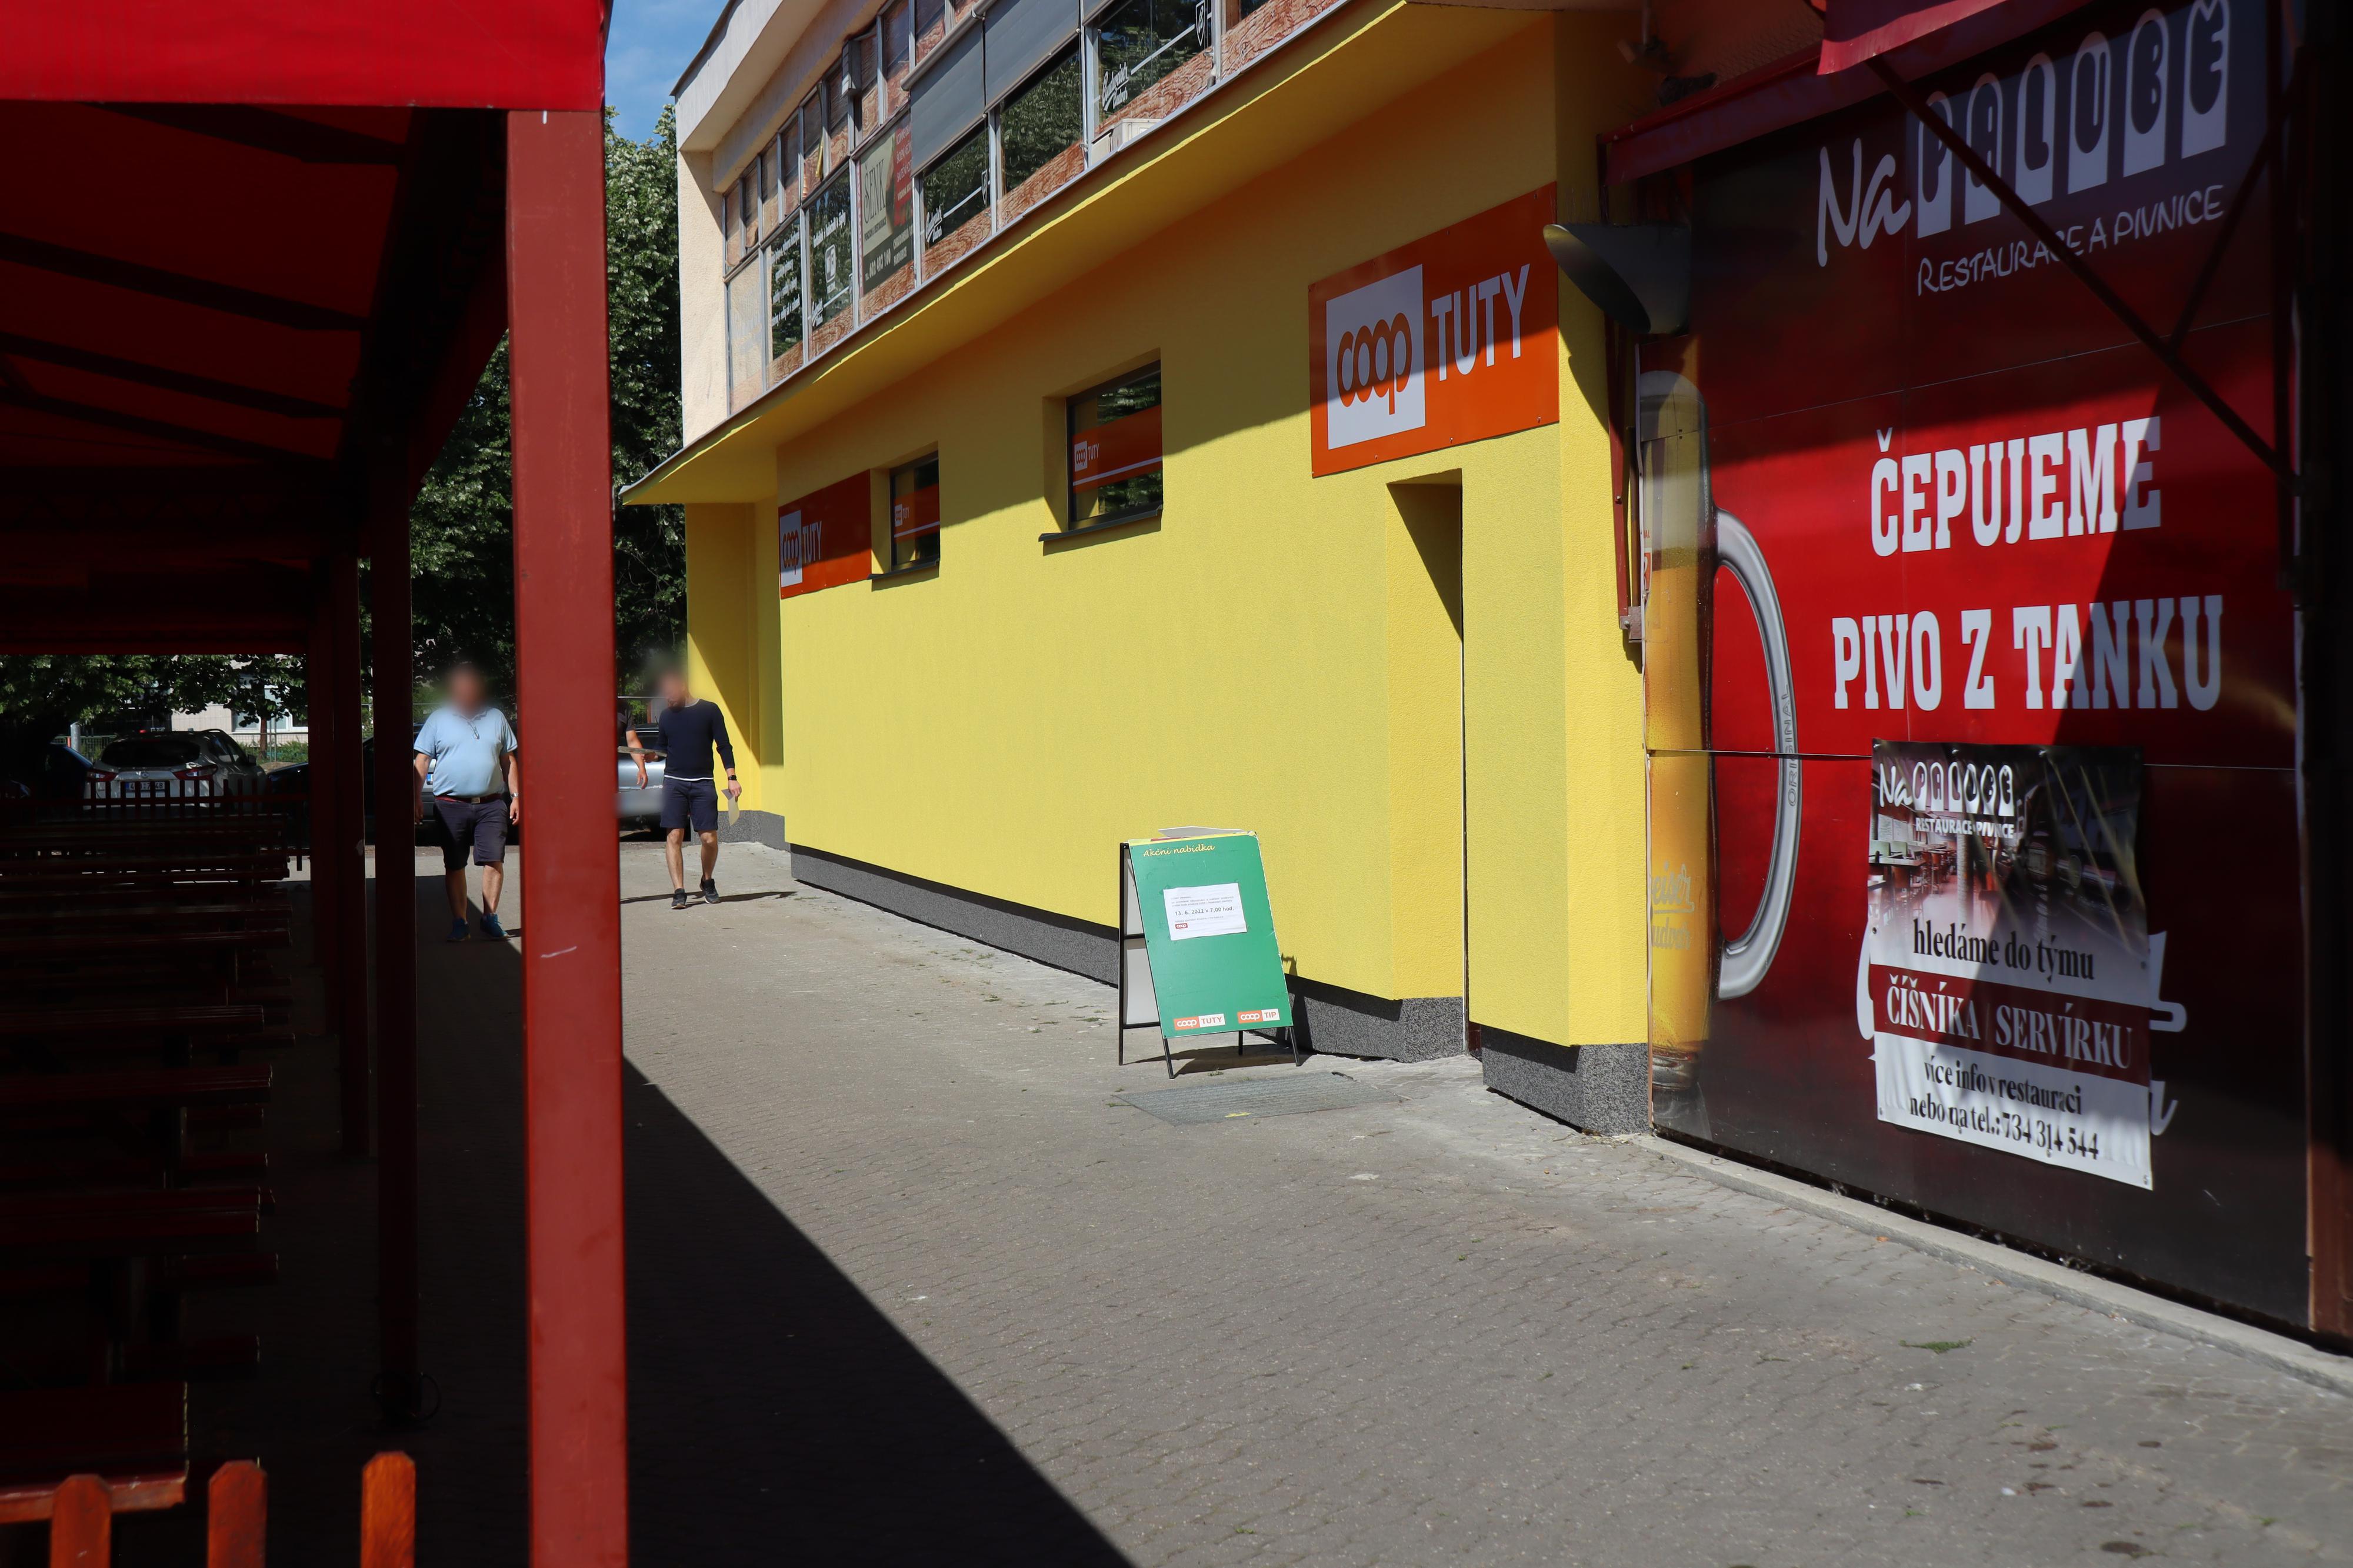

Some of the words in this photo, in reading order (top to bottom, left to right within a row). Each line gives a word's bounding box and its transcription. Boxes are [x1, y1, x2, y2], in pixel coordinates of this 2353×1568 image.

[864, 158, 886, 223] ŠENK
[1818, 138, 1911, 268] Na
[2089, 218, 2107, 253] A
[2114, 185, 2224, 245] PIVNICE
[1337, 312, 1412, 415] coop
[1431, 263, 1531, 382] TUTY
[1088, 443, 1099, 461] TUTY
[1871, 415, 2162, 557] ČEPUJEME
[783, 529, 799, 576] coop
[802, 521, 822, 563] TUTY
[1831, 610, 1942, 711] PIVO
[1961, 609, 1996, 709] Z
[2012, 595, 2224, 711] TANKU
[1879, 763, 1914, 808] Na
[1173, 843, 1215, 854] nabídka
[1915, 817, 1973, 835] RESTAURACE
[1913, 918, 1999, 966] hledáme
[2004, 930, 2031, 970] do
[2037, 935, 2095, 983] týmu
[1177, 1019, 1197, 1027] coop
[1201, 1016, 1222, 1025] TUTY
[1240, 1013, 1260, 1021] coop
[1887, 973, 1981, 1040] ČÍŠNÍKA
[1995, 1002, 2133, 1069] SERVÍRKU
[1924, 1055, 1952, 1086] více
[1956, 1060, 1987, 1093] info
[2000, 1078, 2082, 1115] restauraci
[1910, 1093, 1945, 1123] nebo
[1949, 1106, 1968, 1129] na
[2037, 1120, 2063, 1152] 314
[2068, 1127, 2099, 1160] 544
